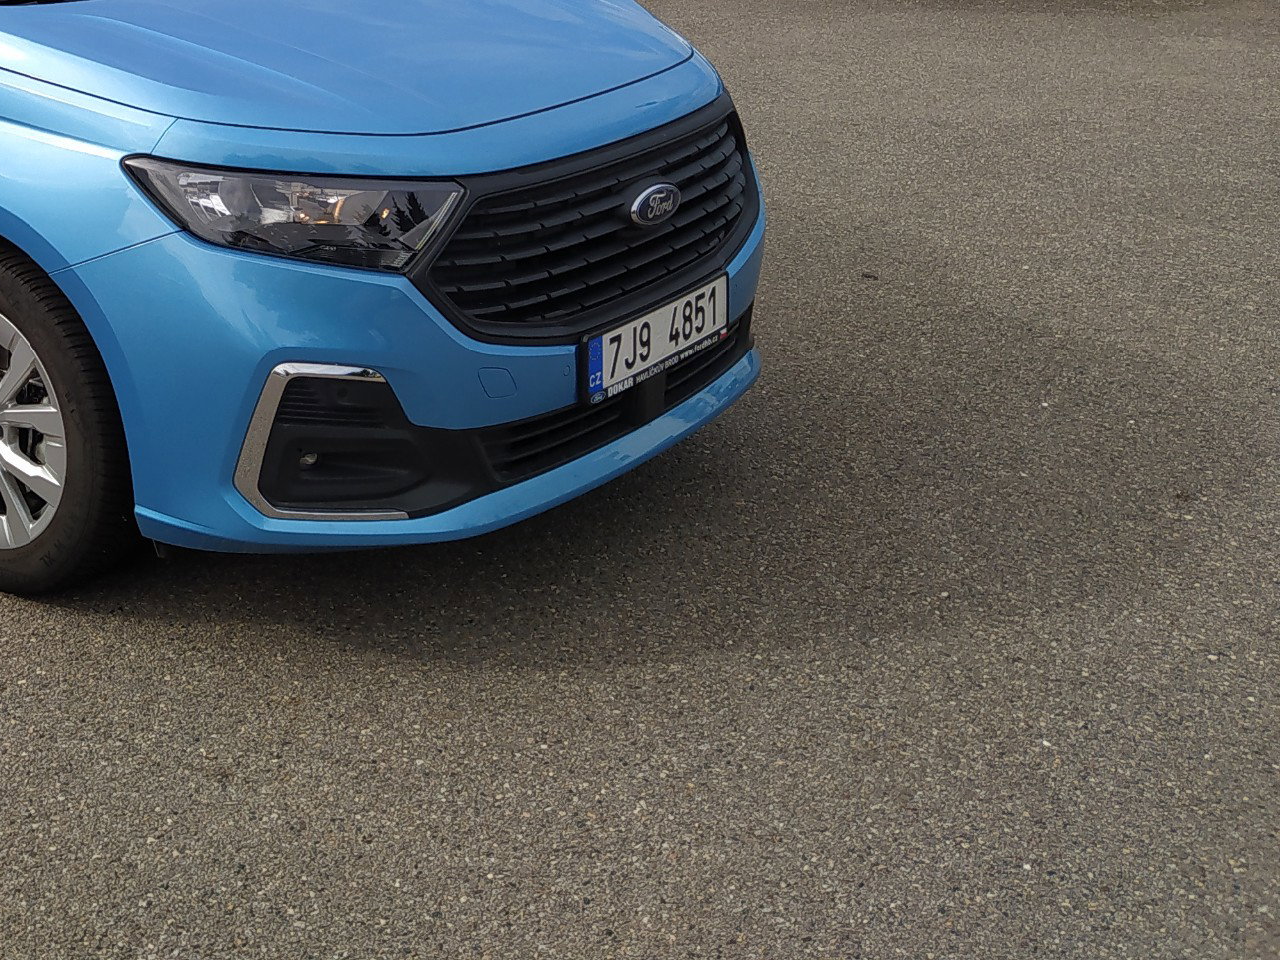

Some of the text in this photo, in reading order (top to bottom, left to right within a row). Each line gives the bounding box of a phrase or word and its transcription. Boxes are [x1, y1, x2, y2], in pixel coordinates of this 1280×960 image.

[646, 191, 674, 219] Ford
[609, 285, 717, 380] 7J9 4851
[589, 371, 602, 389] CZ
[607, 377, 634, 398] DOKAR
